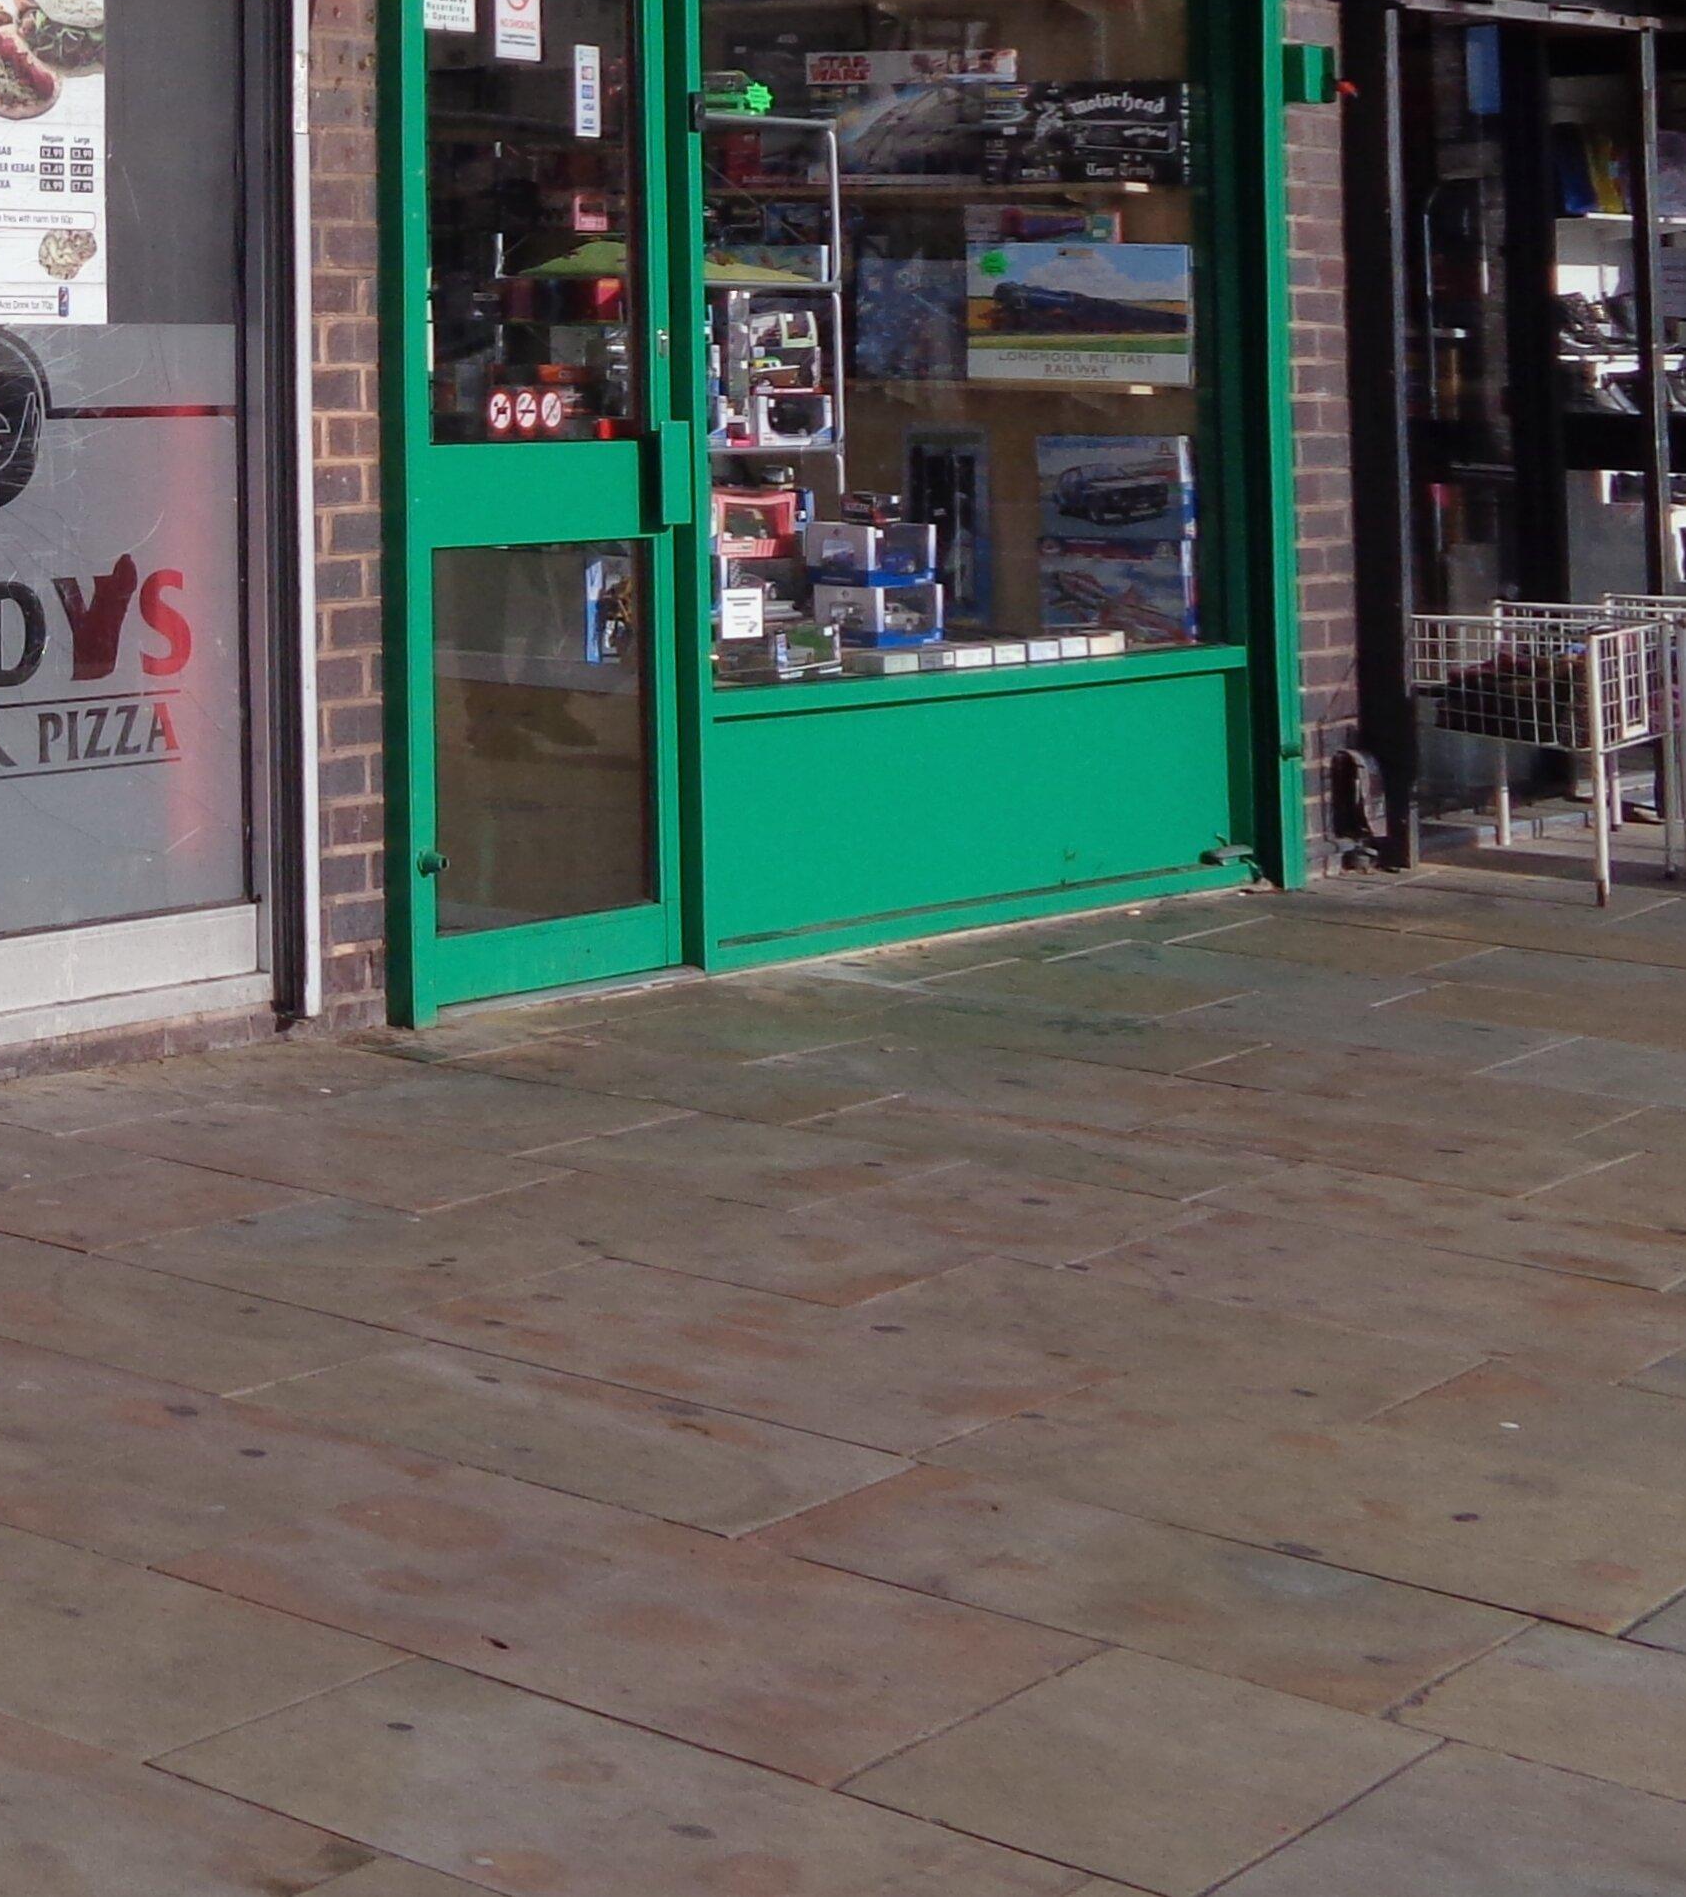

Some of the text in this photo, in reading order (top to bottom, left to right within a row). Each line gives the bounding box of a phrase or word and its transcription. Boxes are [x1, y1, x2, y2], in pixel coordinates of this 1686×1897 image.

[432, 12, 470, 23] Operation
[11, 163, 35, 173] KEBAB
[38, 701, 180, 765] PIZZA
